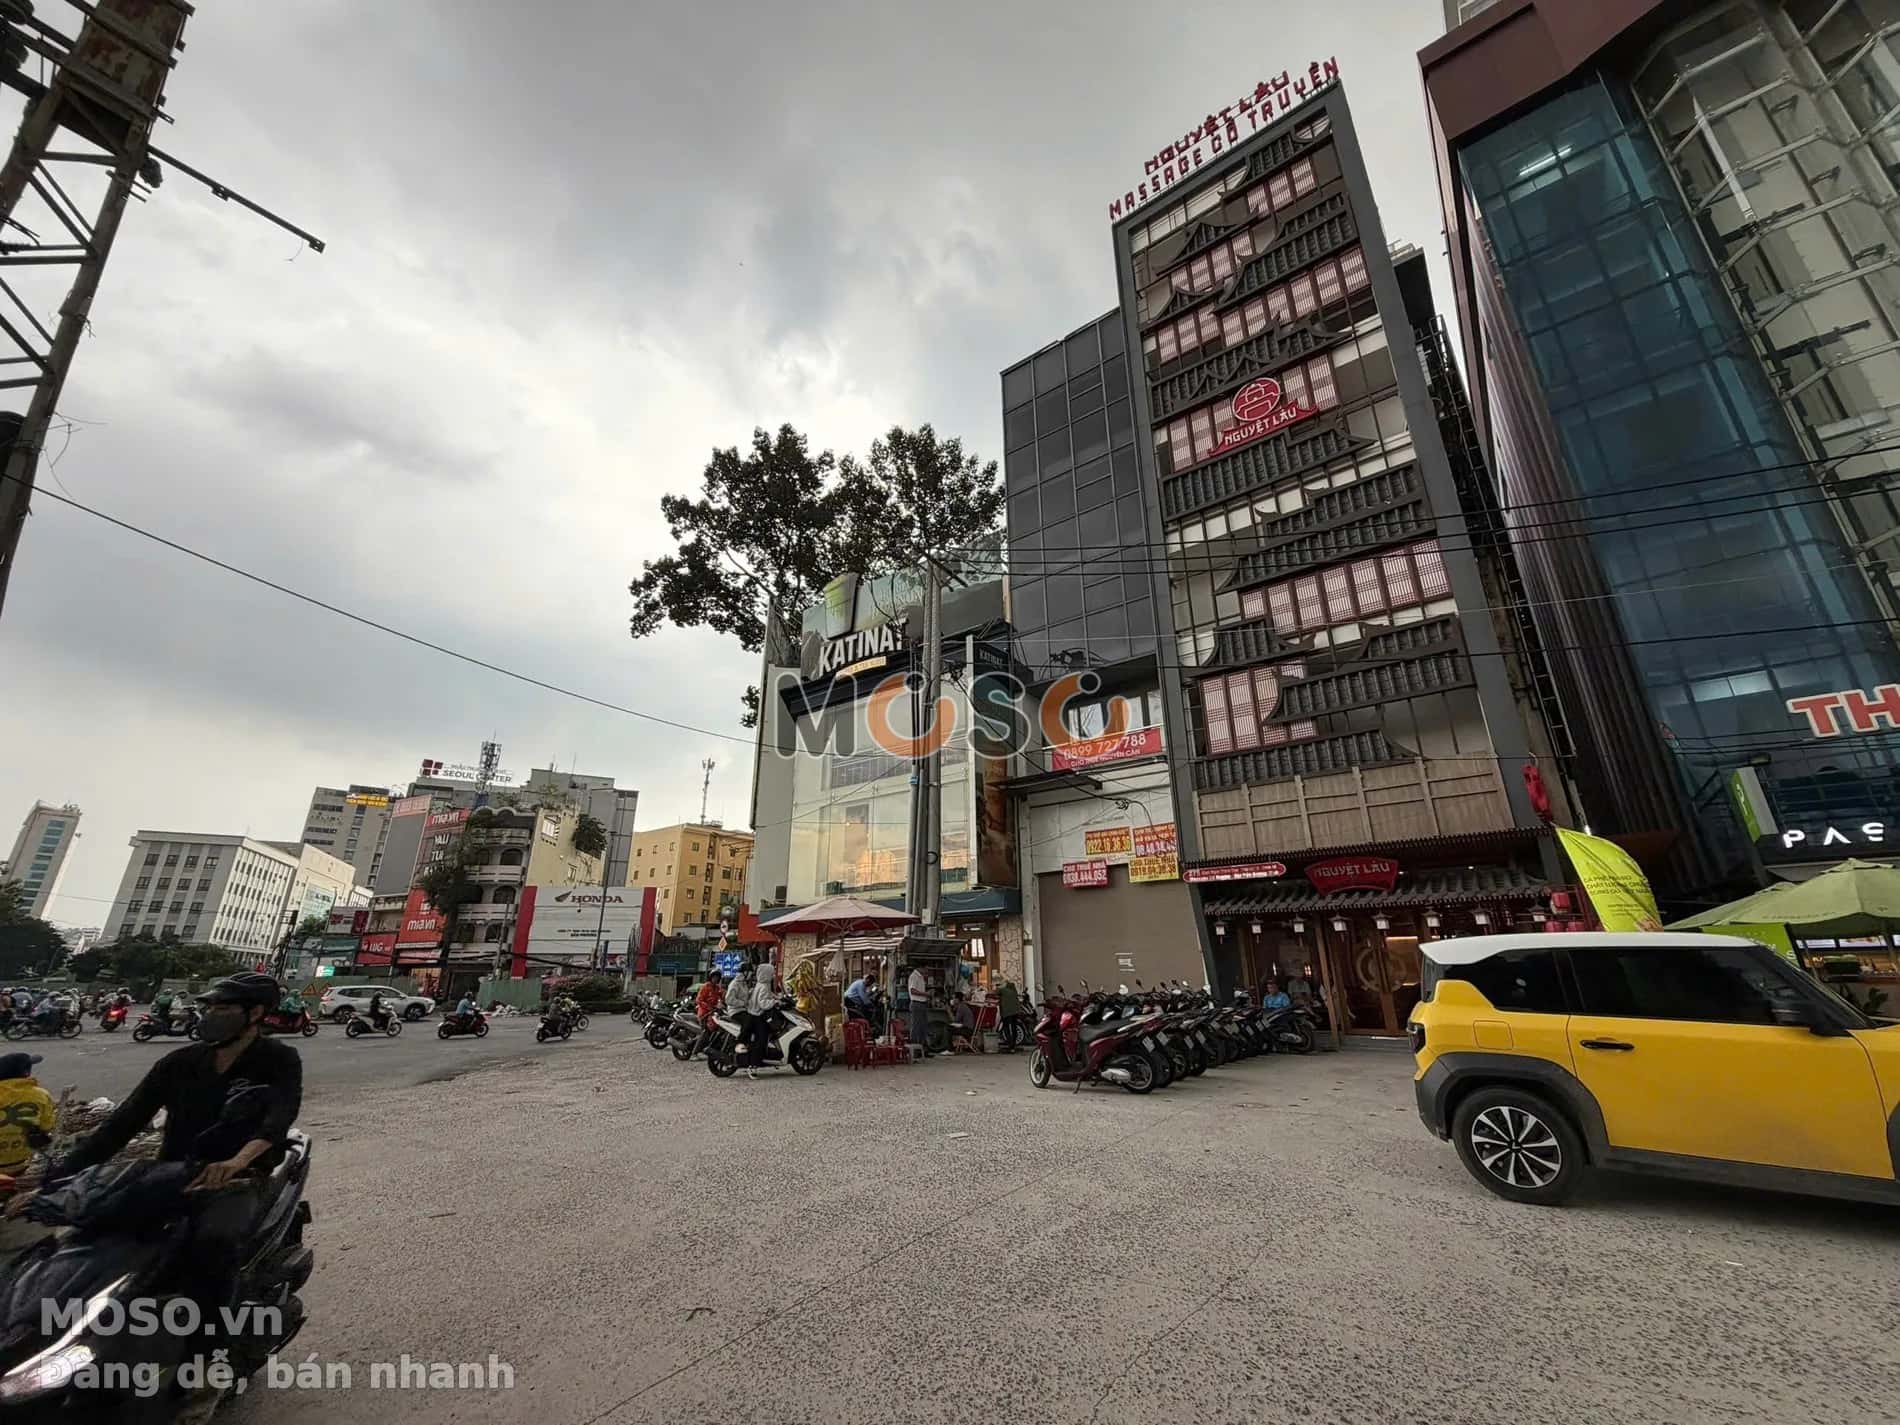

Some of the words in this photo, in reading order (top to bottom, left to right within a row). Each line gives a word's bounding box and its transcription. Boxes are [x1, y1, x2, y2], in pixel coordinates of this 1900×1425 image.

[1109, 148, 1203, 219] MASSAGE
[1224, 418, 1270, 447] NGUYỆT
[1273, 407, 1298, 426] LÂU
[1096, 738, 1119, 756] 727
[1122, 733, 1147, 750] 788
[443, 769, 475, 780] SEOUL
[475, 772, 512, 783] CTER
[1363, 860, 1391, 874] LÂU
[571, 895, 624, 904] HONDA
